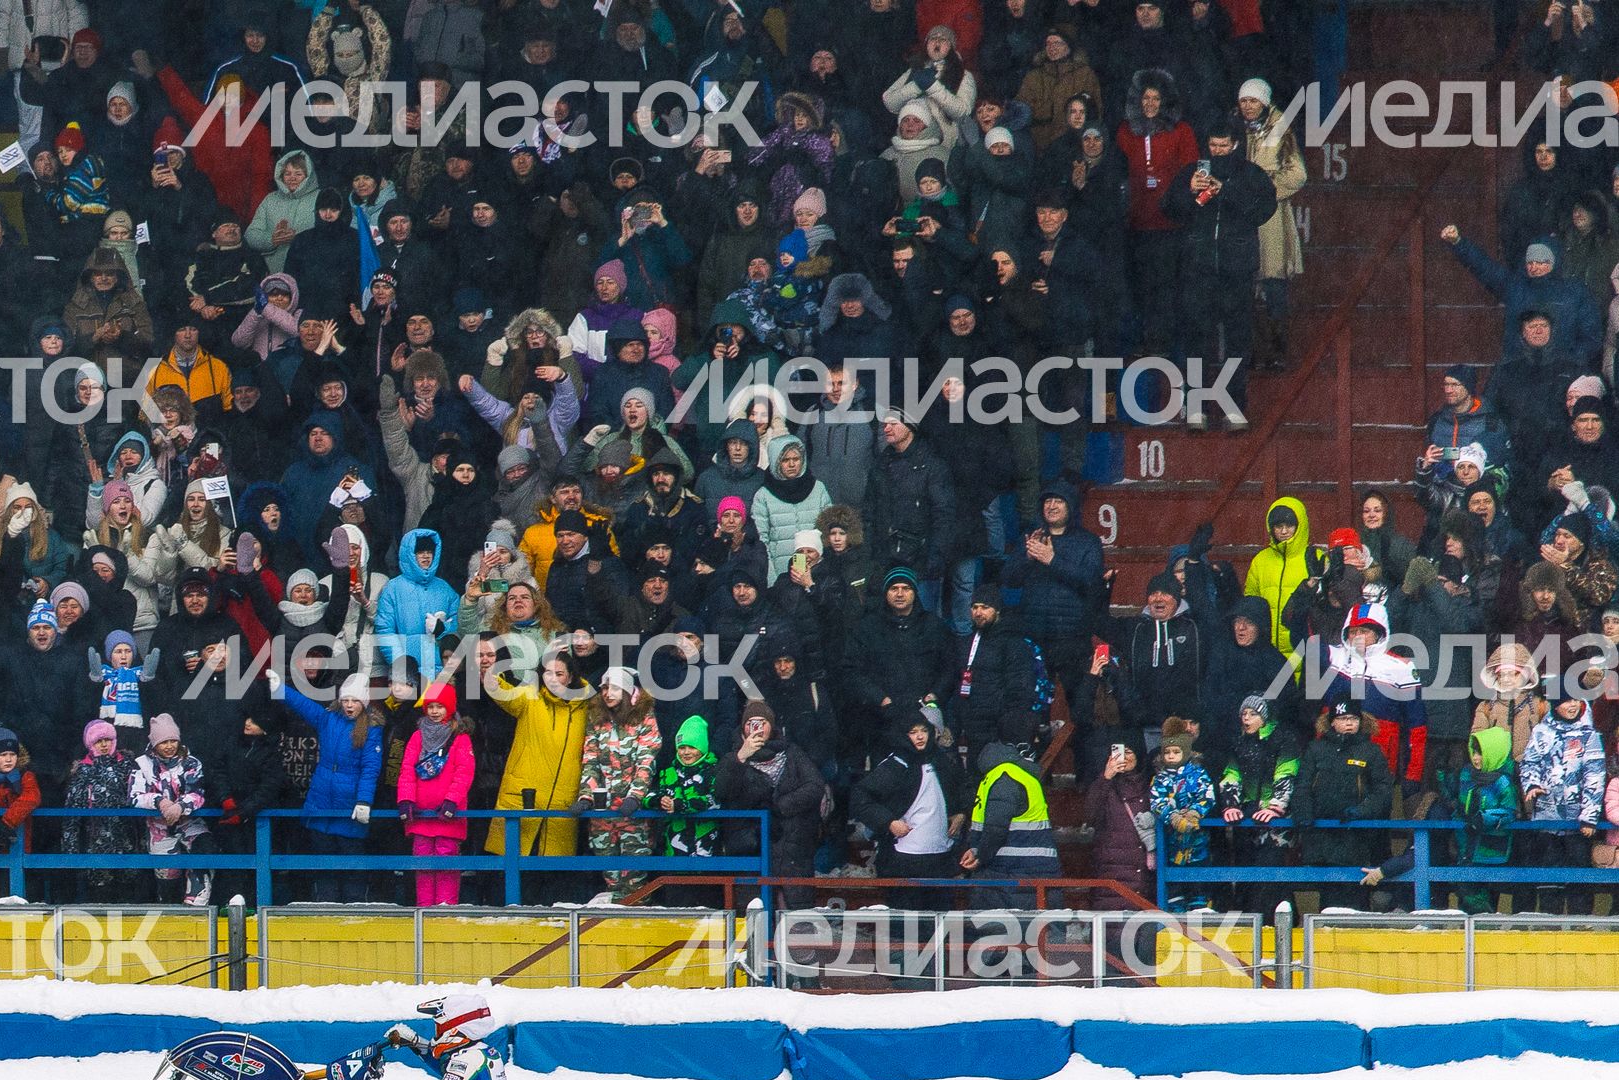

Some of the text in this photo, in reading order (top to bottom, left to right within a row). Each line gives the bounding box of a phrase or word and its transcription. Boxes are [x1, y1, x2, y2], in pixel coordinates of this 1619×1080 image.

[1322, 143, 1347, 182] 15
[1138, 440, 1165, 477] 10
[1099, 504, 1118, 544] 9
